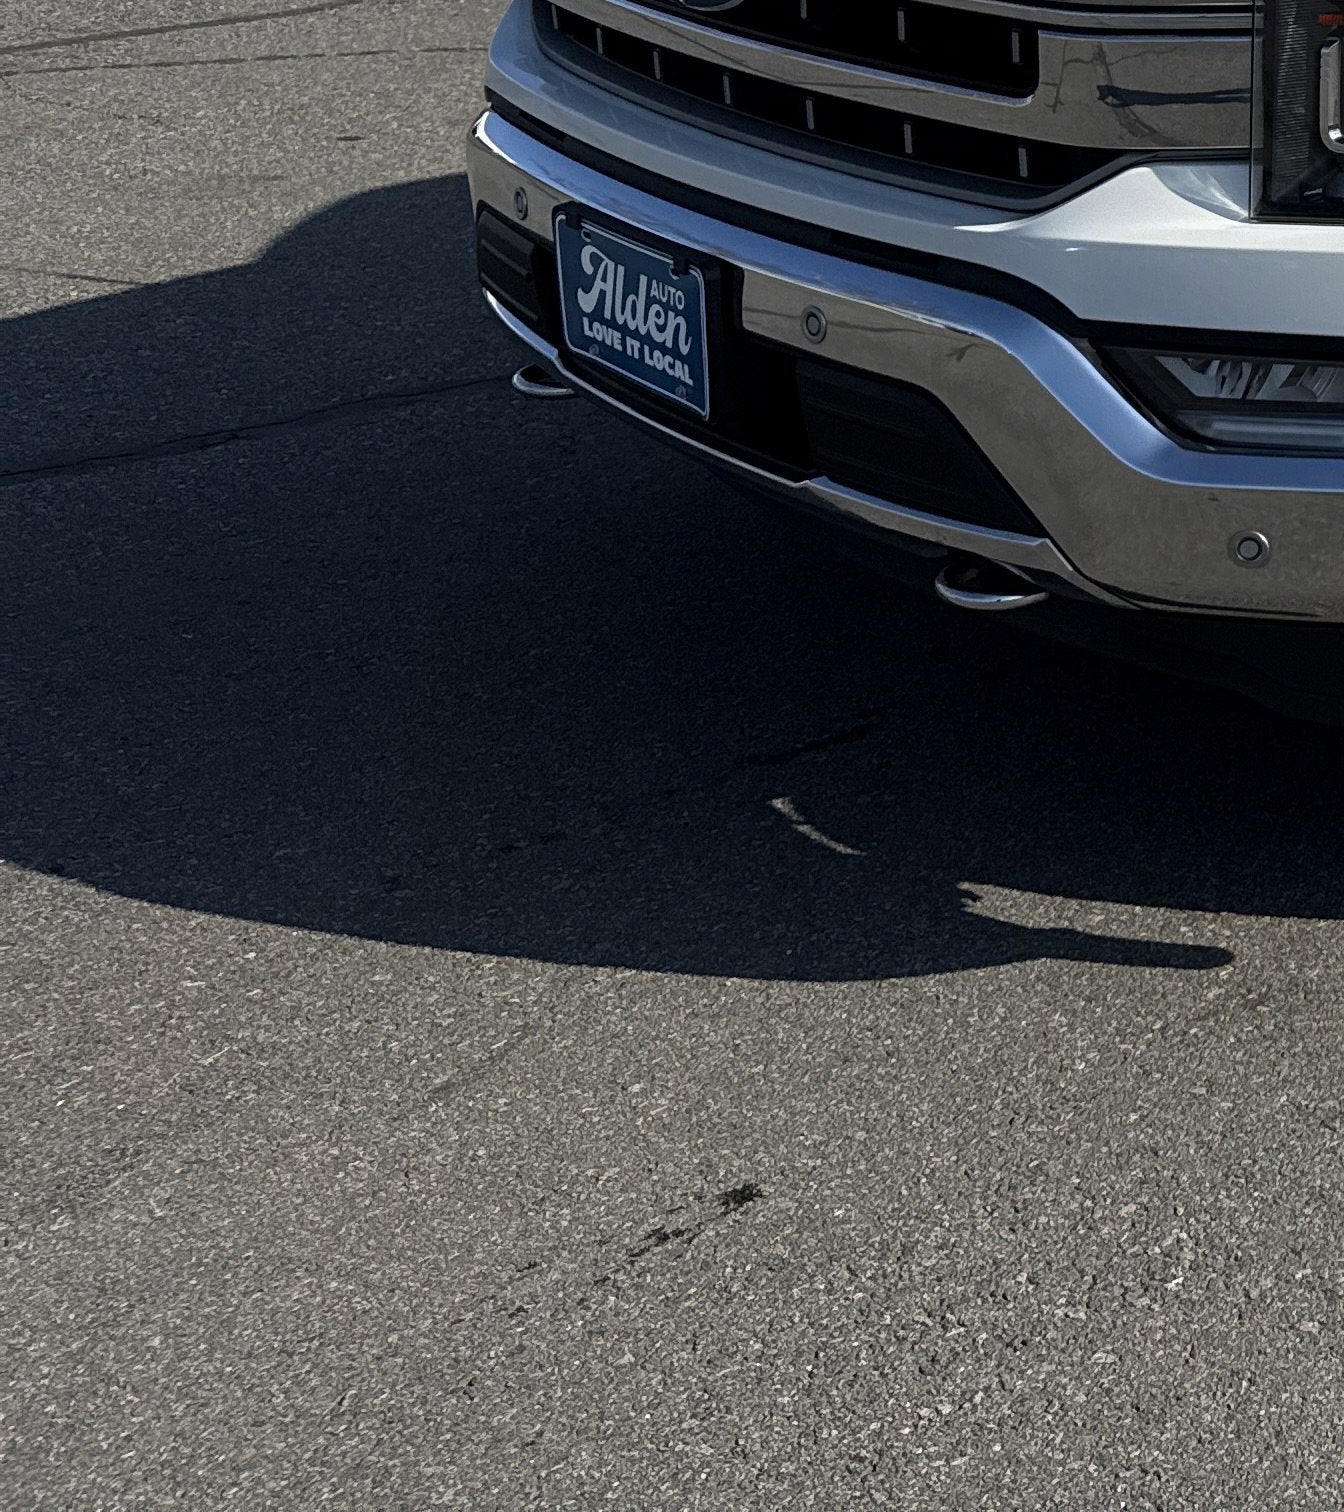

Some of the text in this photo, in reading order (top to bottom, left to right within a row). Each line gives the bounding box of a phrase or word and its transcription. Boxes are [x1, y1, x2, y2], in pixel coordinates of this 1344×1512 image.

[577, 244, 692, 356] Alden
[649, 279, 686, 310] AUTO
[582, 316, 694, 386] LOVE IT LOCAL
